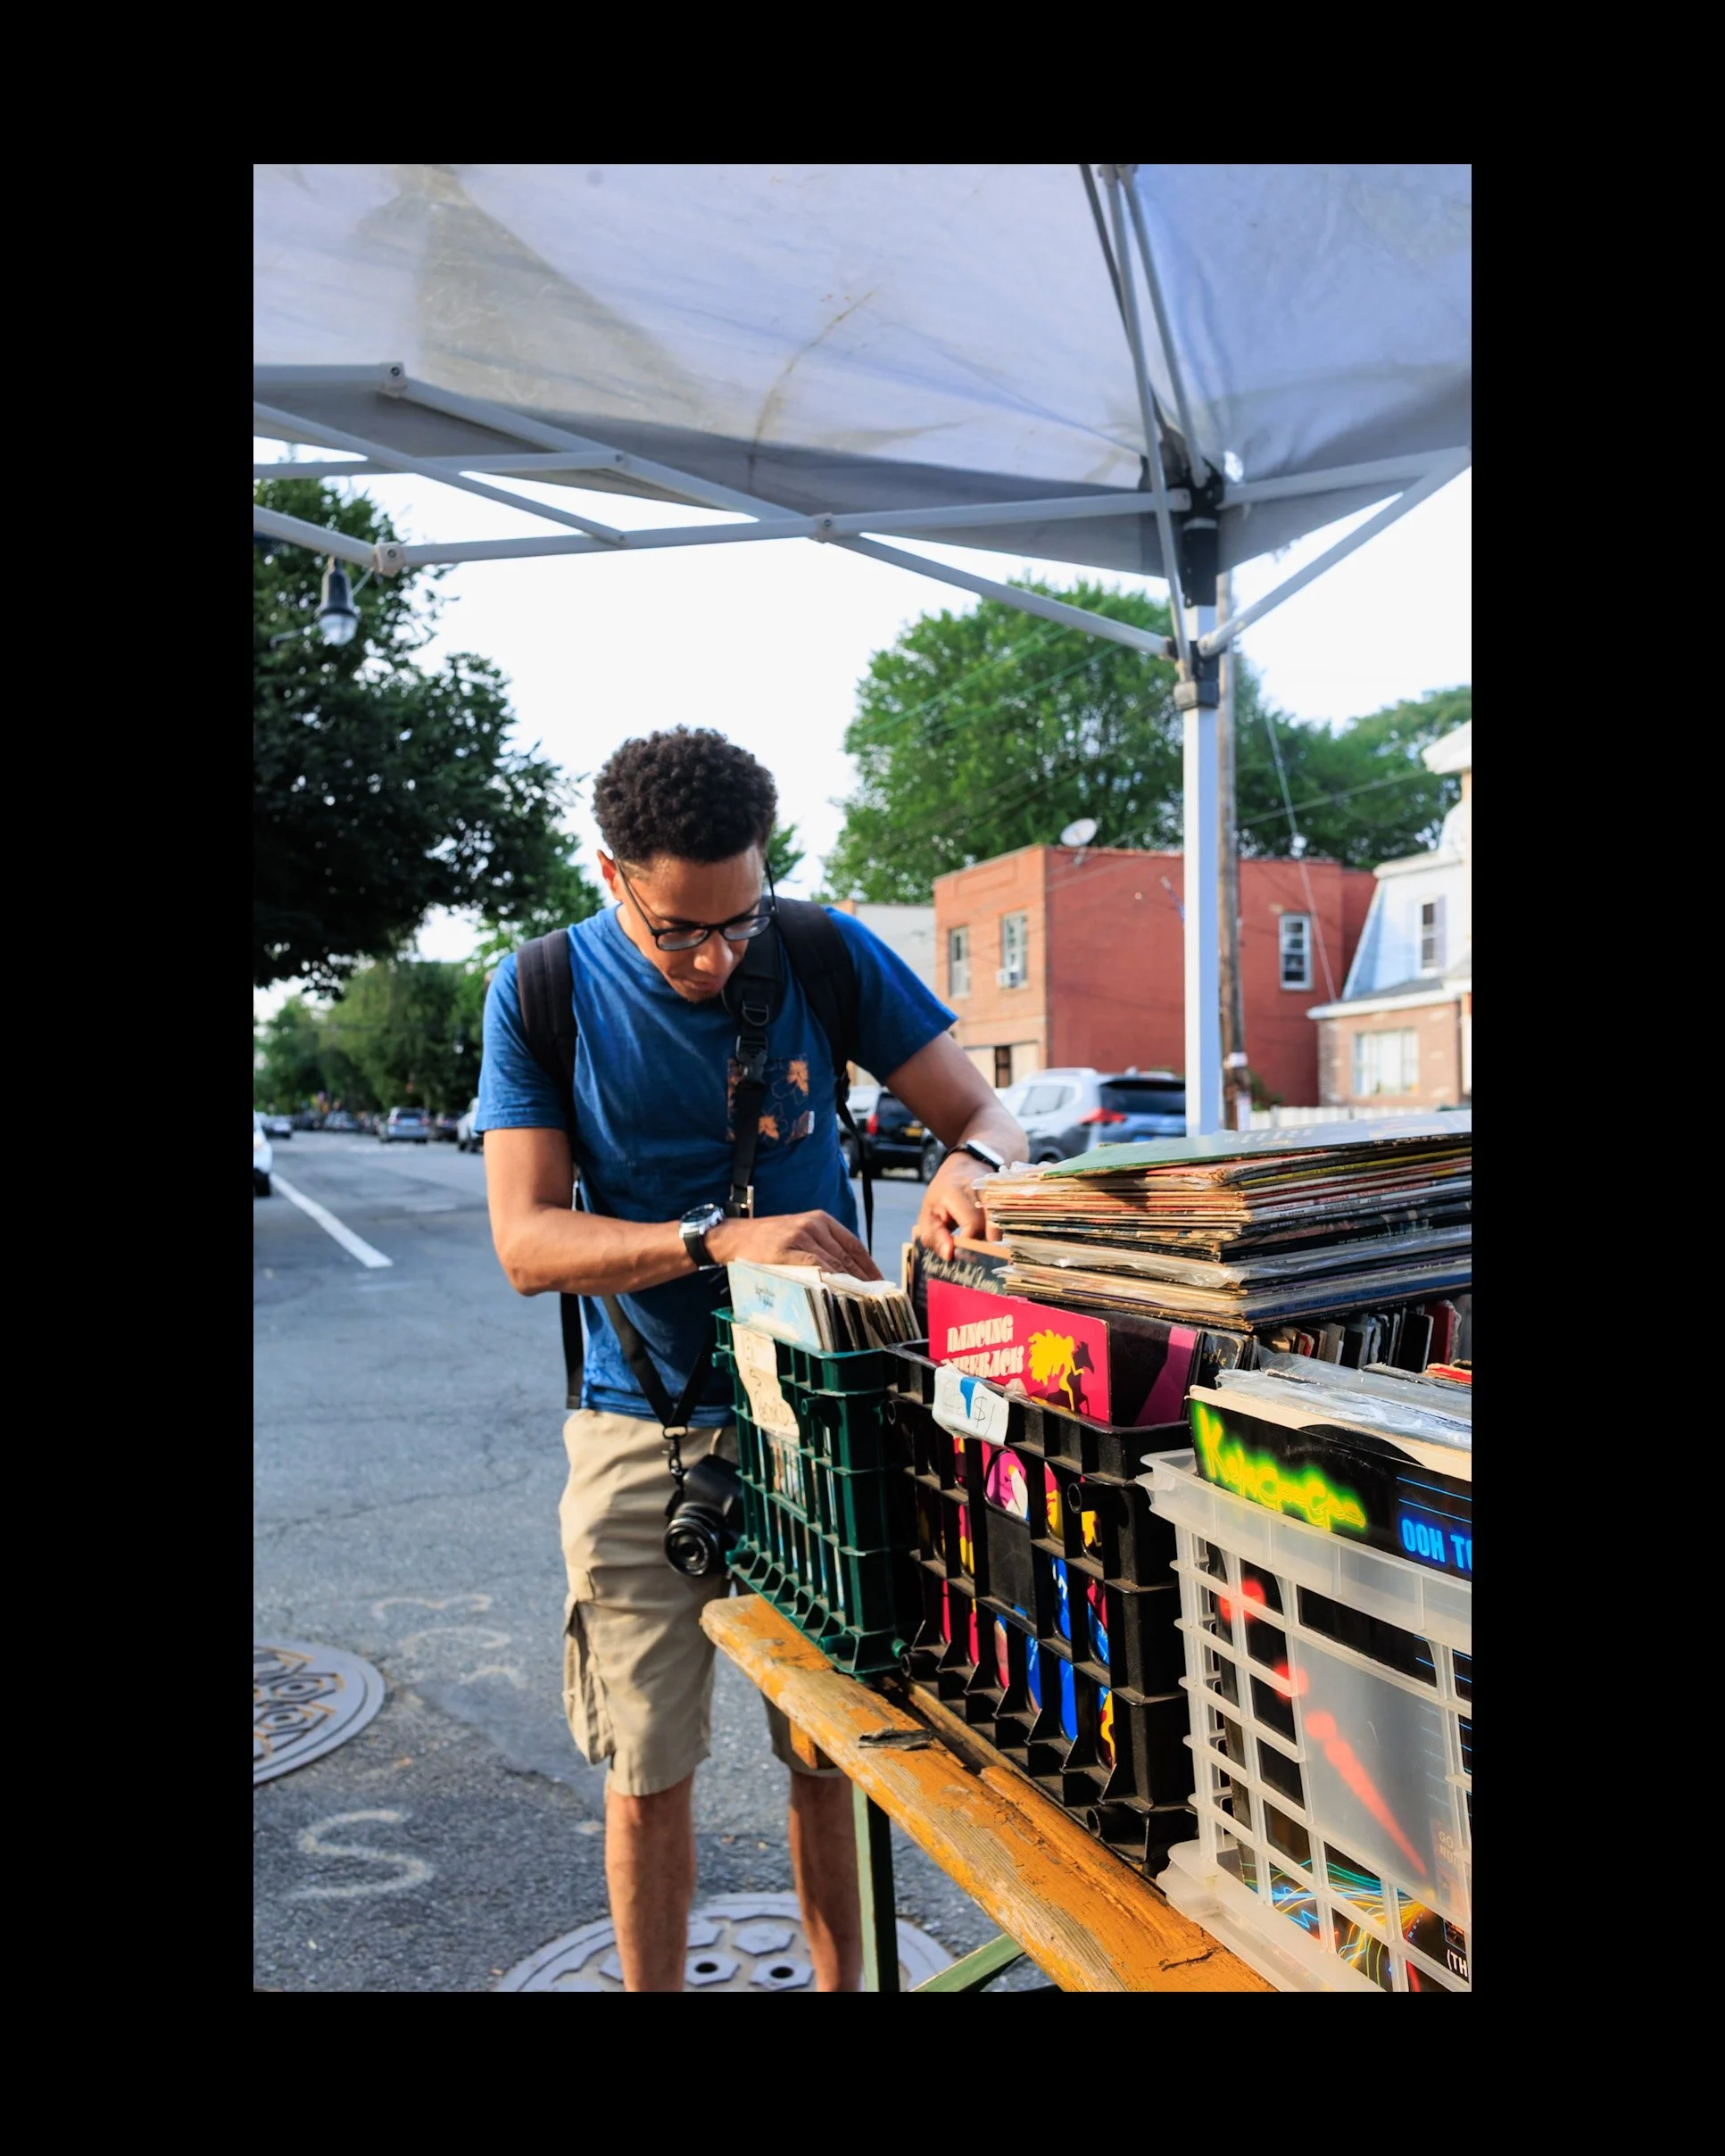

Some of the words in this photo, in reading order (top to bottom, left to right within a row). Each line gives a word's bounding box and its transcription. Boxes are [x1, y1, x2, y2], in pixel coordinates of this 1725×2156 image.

[947, 1314, 1014, 1354] DANCING
[940, 1345, 1024, 1379] AREBACK
[1401, 1519, 1445, 1563] OOH
